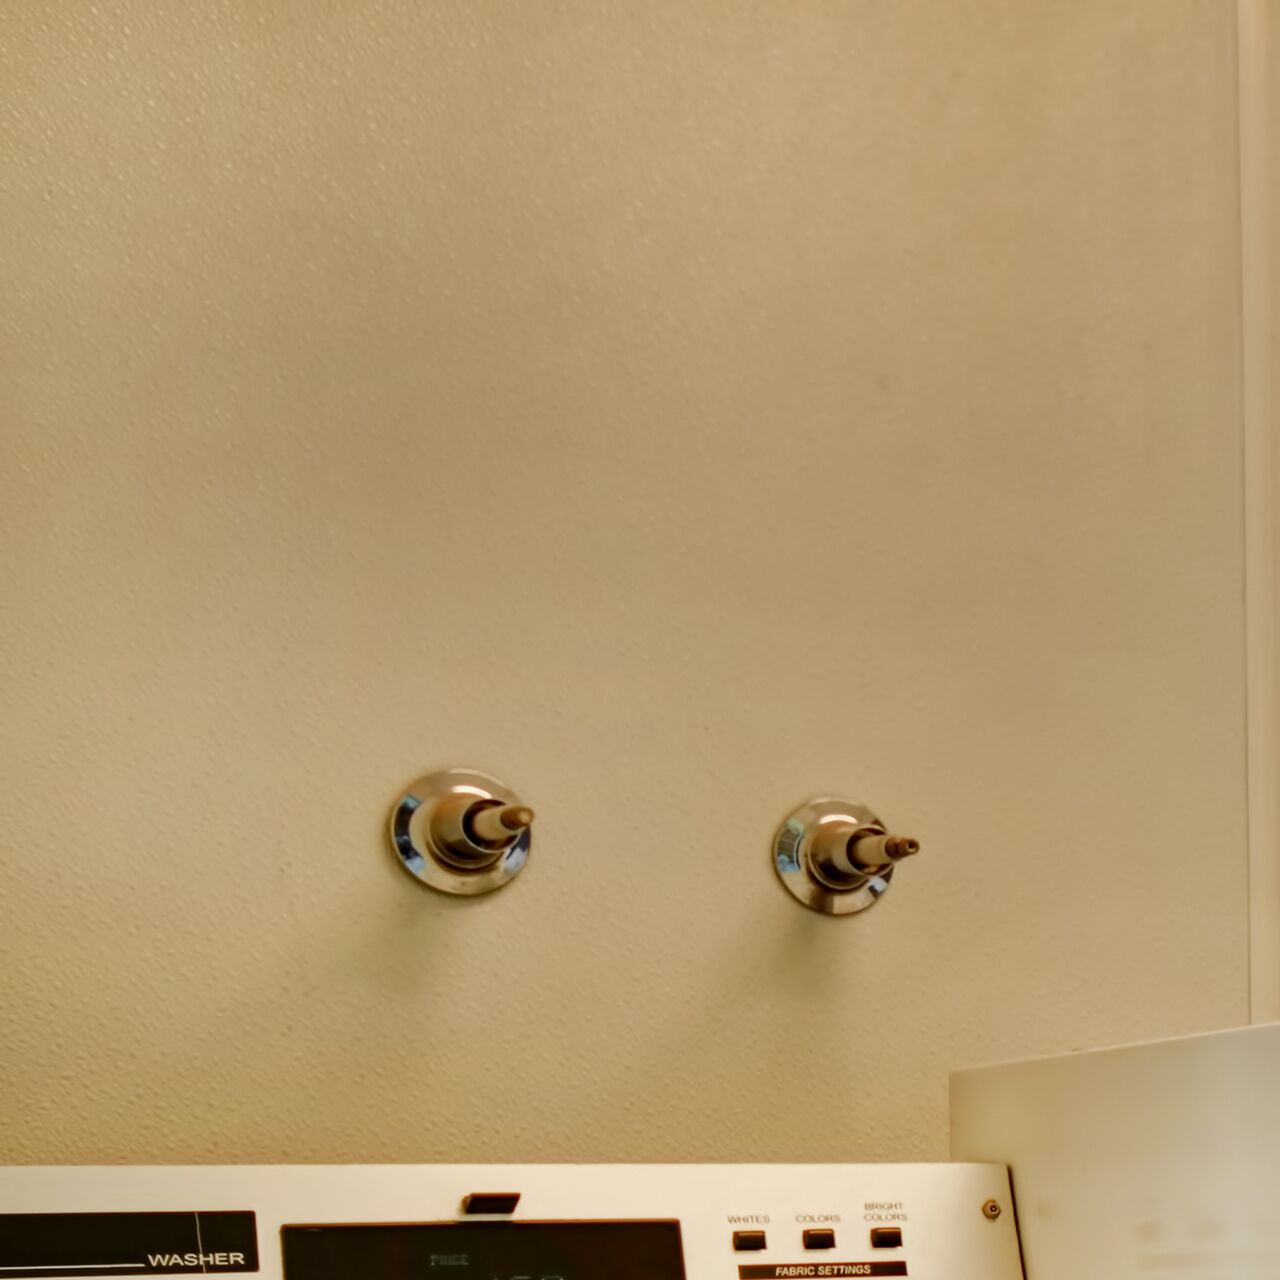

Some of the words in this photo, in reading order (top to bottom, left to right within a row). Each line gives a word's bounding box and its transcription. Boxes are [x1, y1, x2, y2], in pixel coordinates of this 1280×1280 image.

[727, 1215, 770, 1224] WHITES
[796, 1215, 841, 1223] COLORS
[864, 1213, 908, 1222] COLORS
[147, 1252, 245, 1267] WASHER
[775, 1266, 815, 1276] FABRIC
[817, 1264, 872, 1276] SETTINGS
